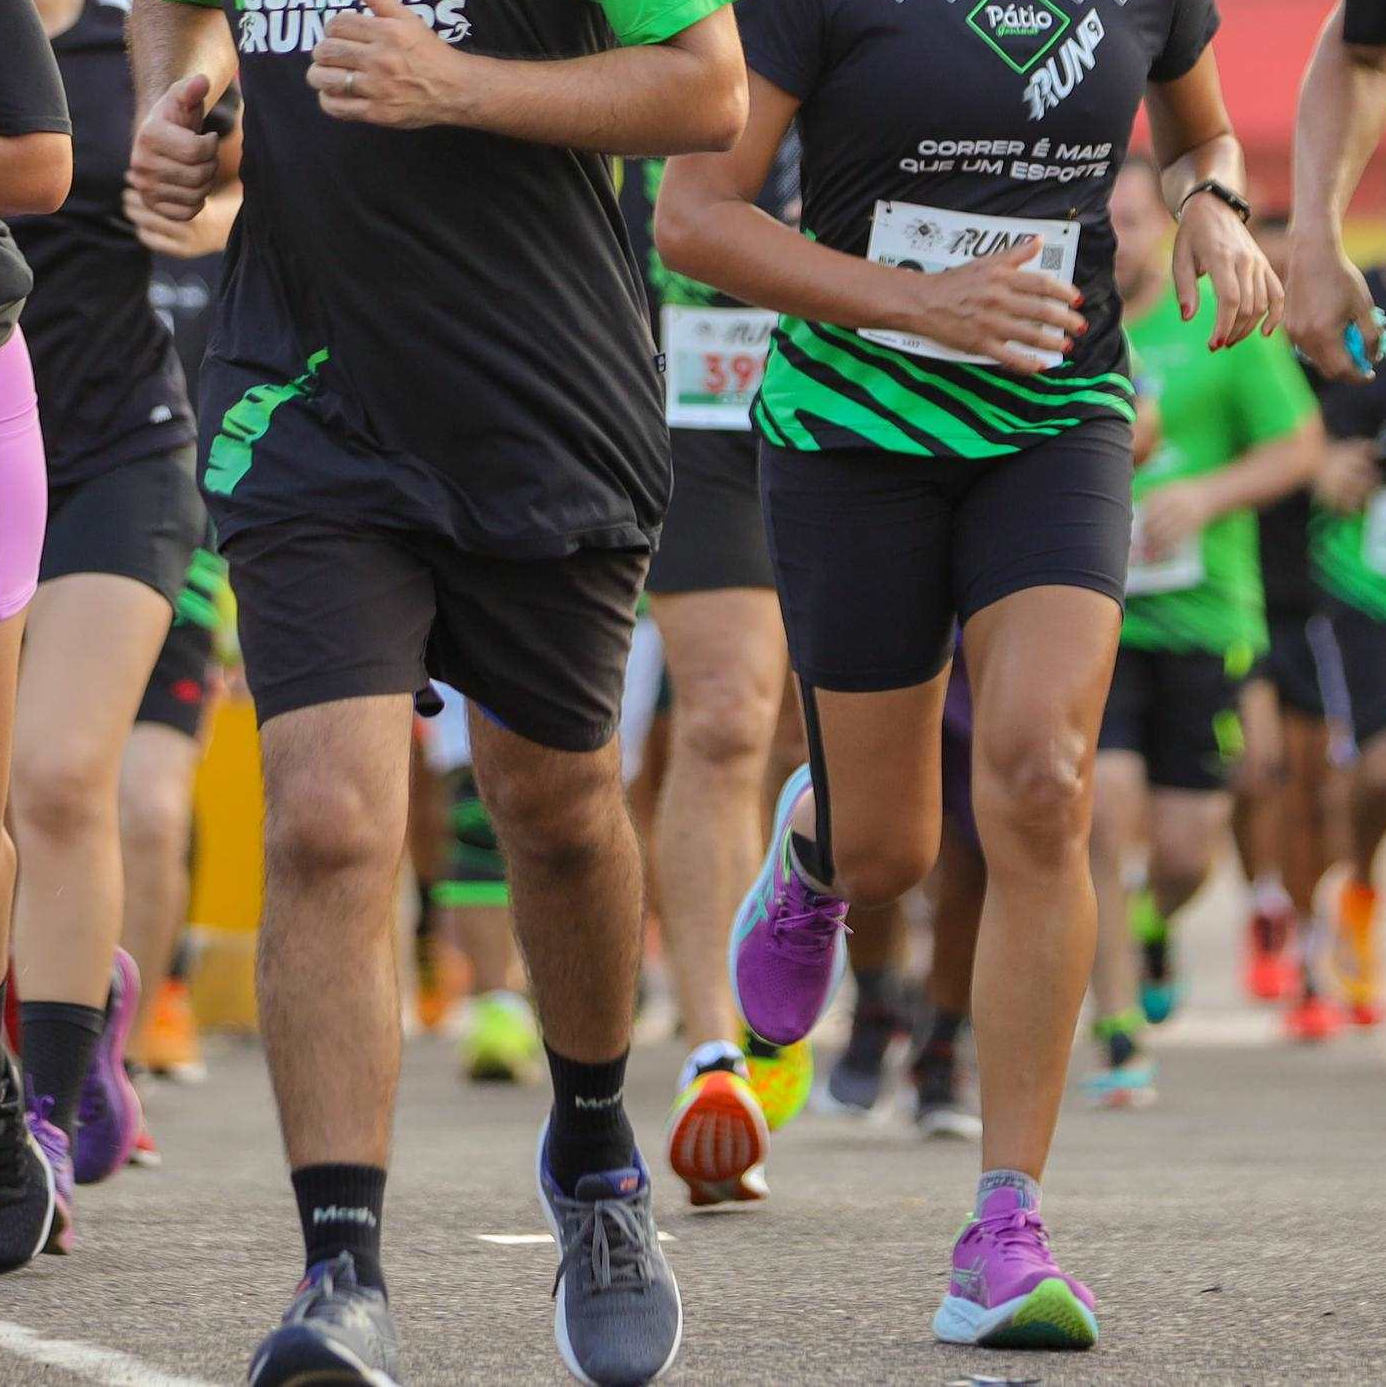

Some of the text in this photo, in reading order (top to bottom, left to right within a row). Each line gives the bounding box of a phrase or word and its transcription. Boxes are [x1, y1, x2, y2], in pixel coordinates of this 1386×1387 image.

[985, 3, 1053, 30] Pátio
[917, 137, 1113, 161] CORRER É MAIS
[961, 159, 1004, 175] UM
[1010, 160, 1111, 183] ESPORTE
[702, 352, 767, 394] 39
